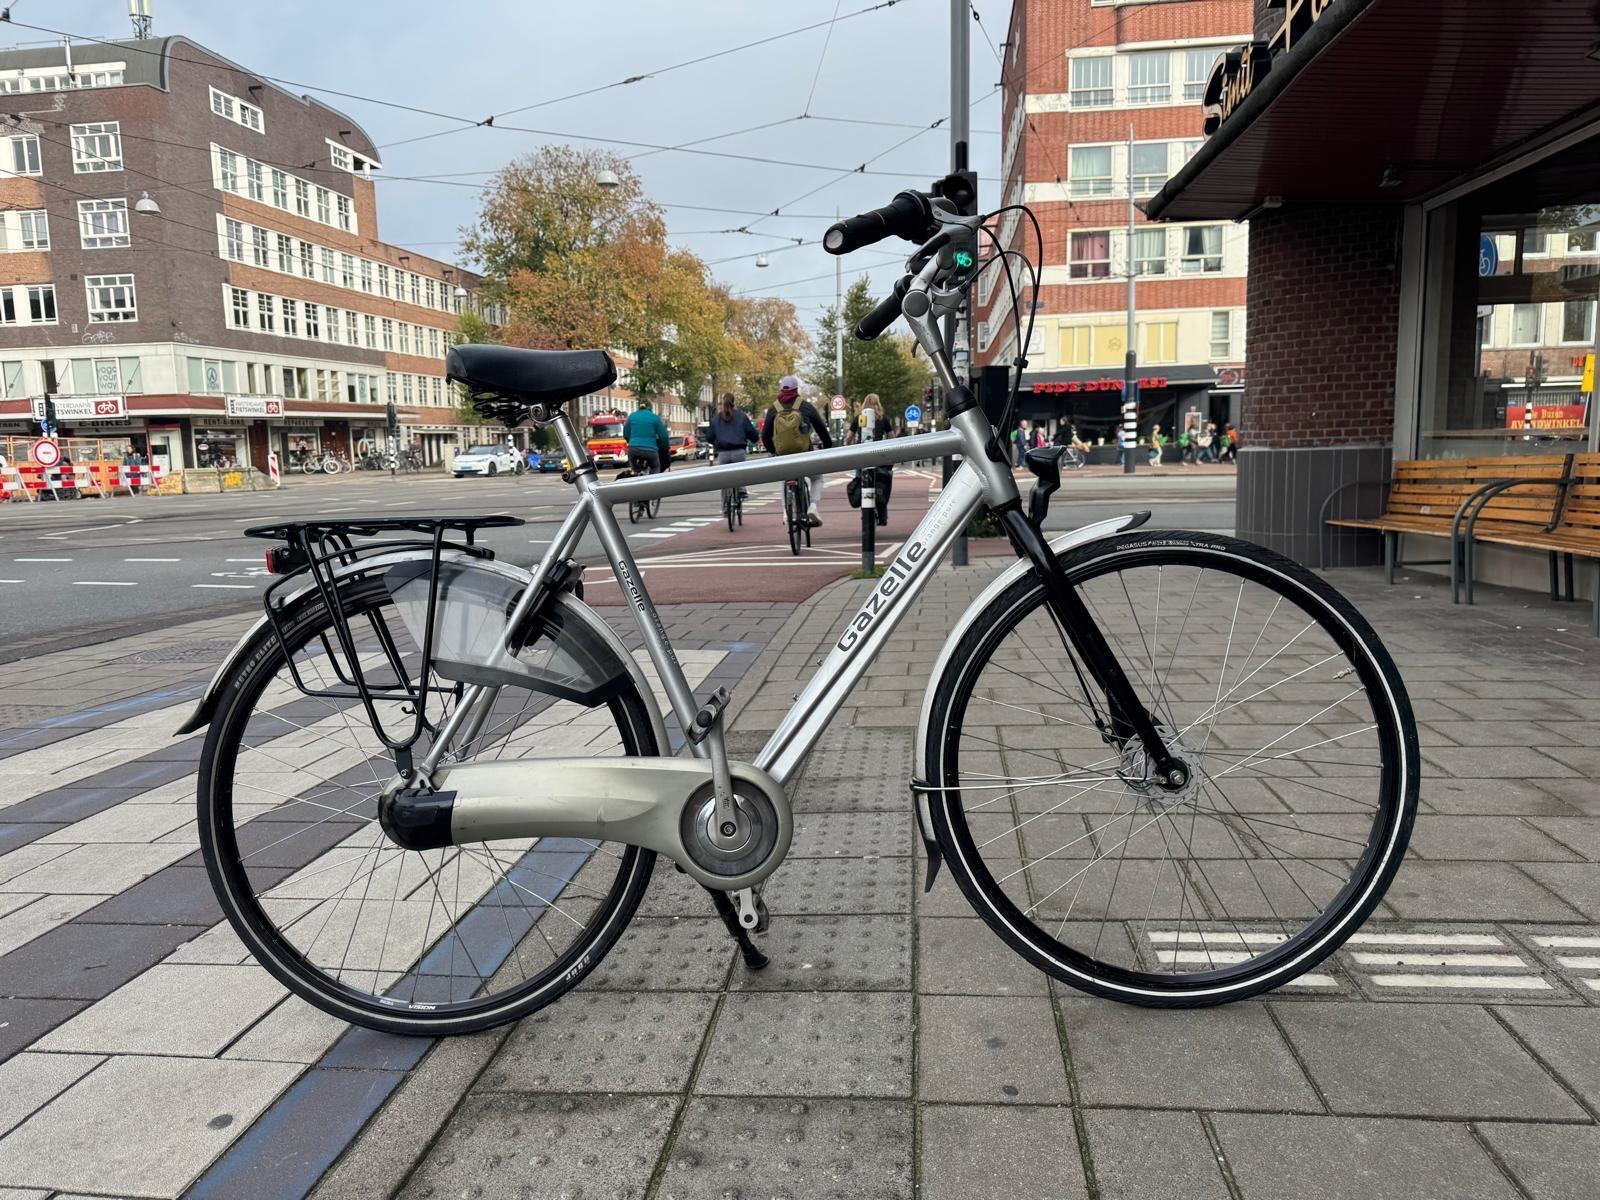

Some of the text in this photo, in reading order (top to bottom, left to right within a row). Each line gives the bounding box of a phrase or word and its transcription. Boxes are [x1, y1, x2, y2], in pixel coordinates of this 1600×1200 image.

[1116, 540, 1148, 551] PEGASUS
[618, 560, 646, 612] Gazelle
[837, 541, 927, 652] Gazelle
